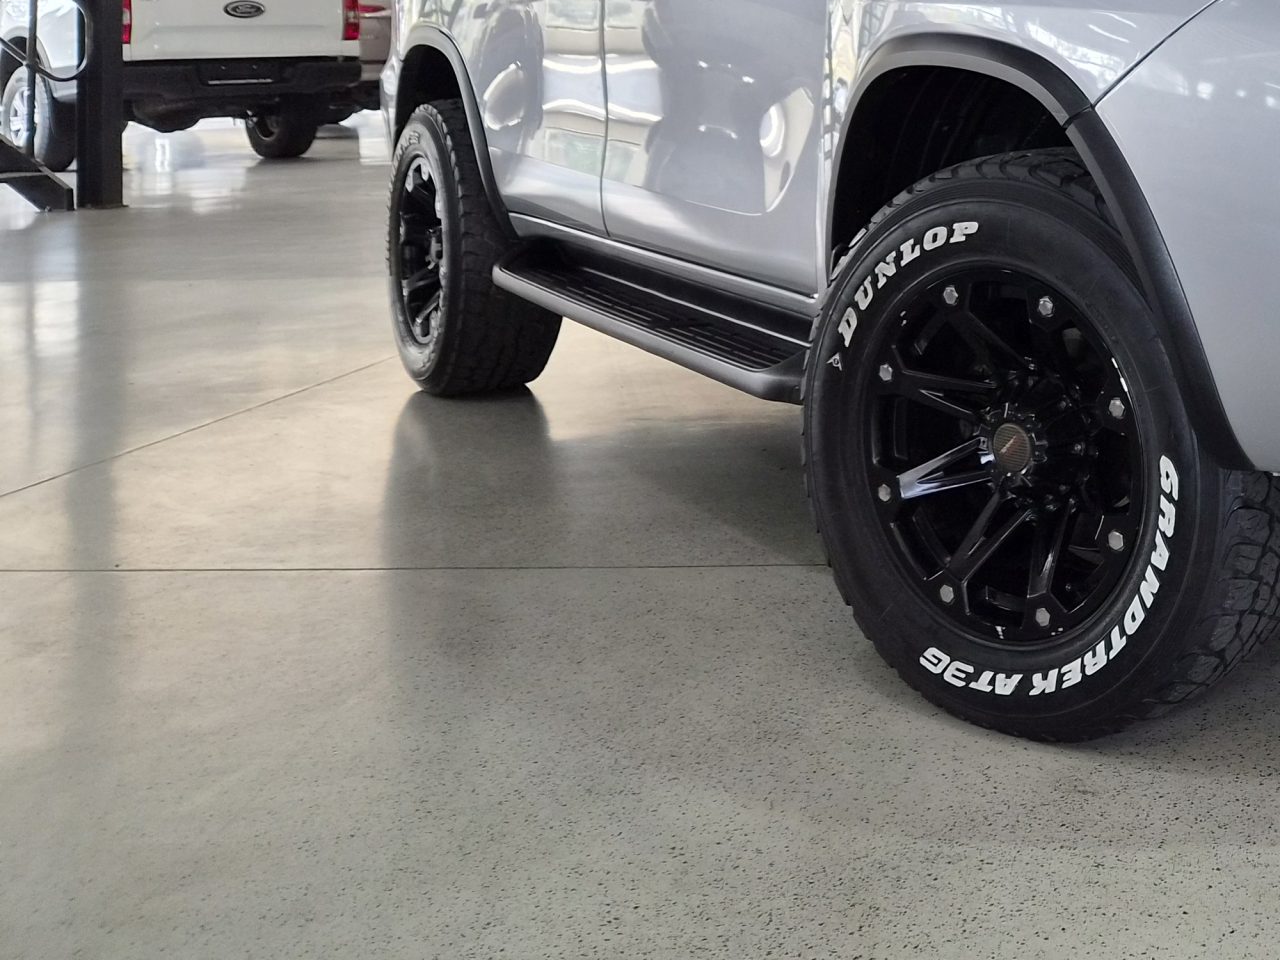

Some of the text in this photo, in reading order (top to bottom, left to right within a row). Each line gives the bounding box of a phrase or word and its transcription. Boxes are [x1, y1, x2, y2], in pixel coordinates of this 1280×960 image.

[837, 221, 979, 348] DUNLOP
[919, 454, 1179, 696] GRANDTREK AT3G
